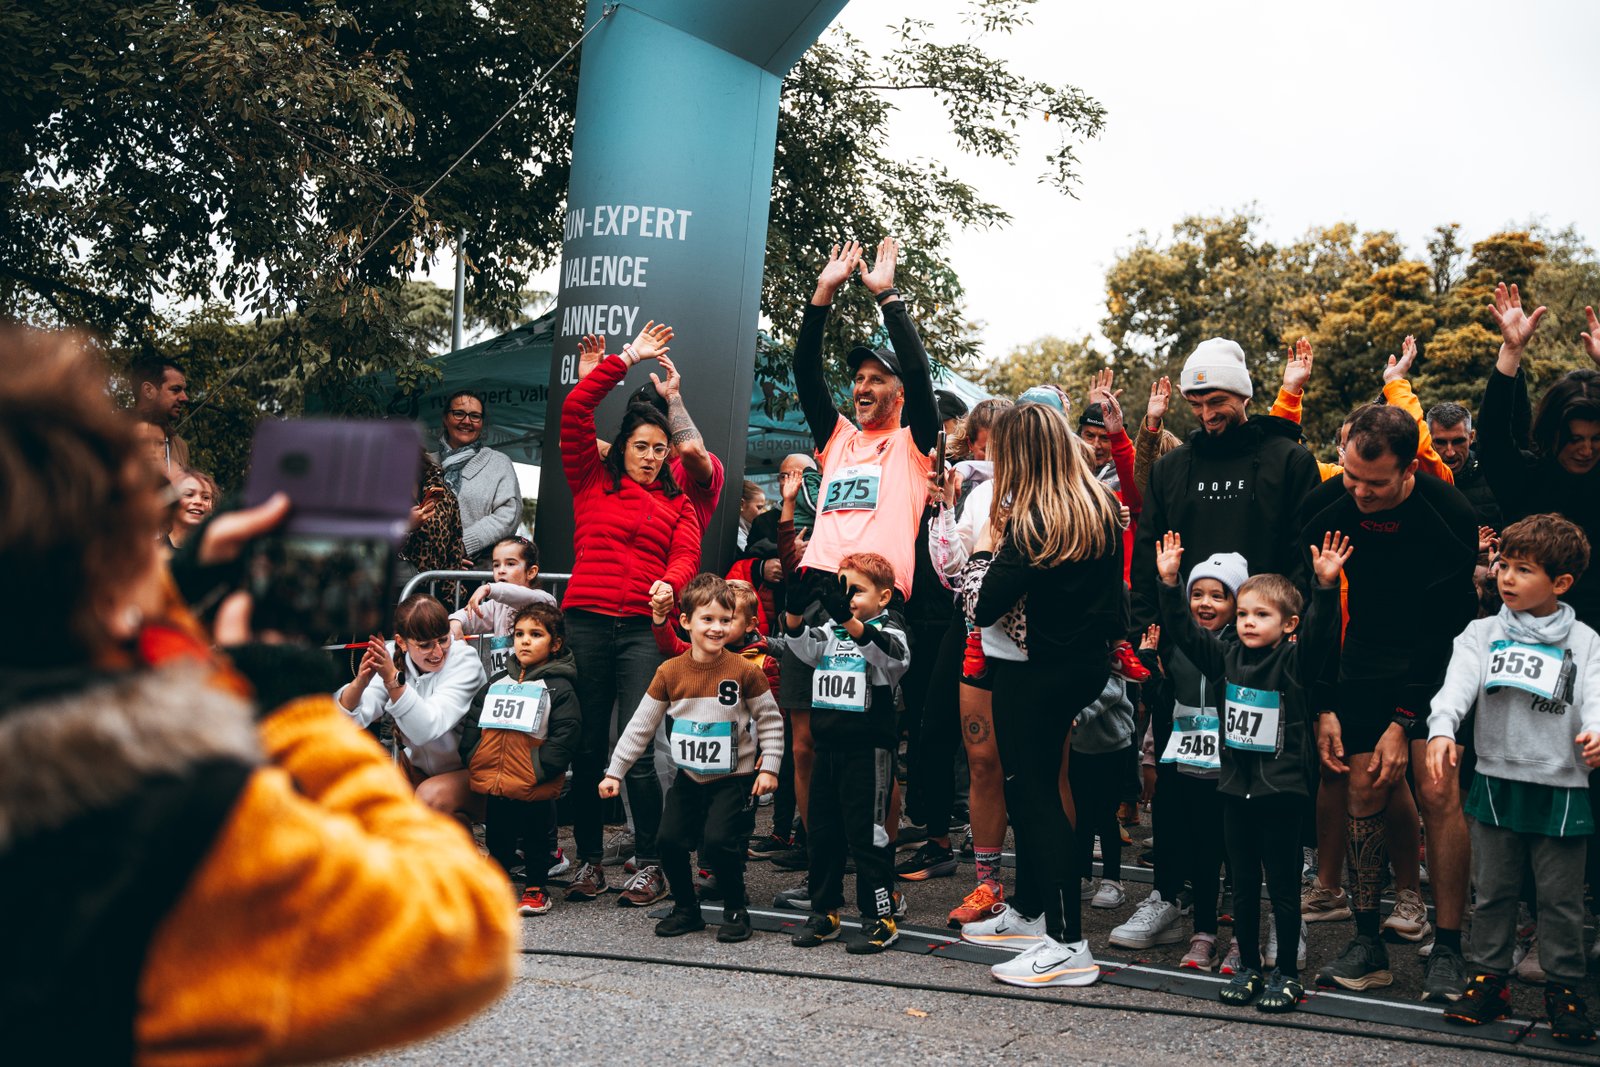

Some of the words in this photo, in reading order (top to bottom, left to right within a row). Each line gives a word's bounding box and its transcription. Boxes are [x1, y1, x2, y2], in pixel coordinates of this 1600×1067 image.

[564, 255, 649, 289] VALENCE
[561, 304, 640, 337] ANNECY
[829, 479, 870, 503] 375
[1198, 479, 1245, 492] DOPE
[1490, 651, 1544, 680] 553
[718, 679, 740, 707] S
[818, 674, 856, 699] 1104
[492, 698, 525, 720] 551
[1227, 706, 1263, 738] 547
[678, 739, 721, 764] 1142
[1176, 734, 1217, 757] 548
